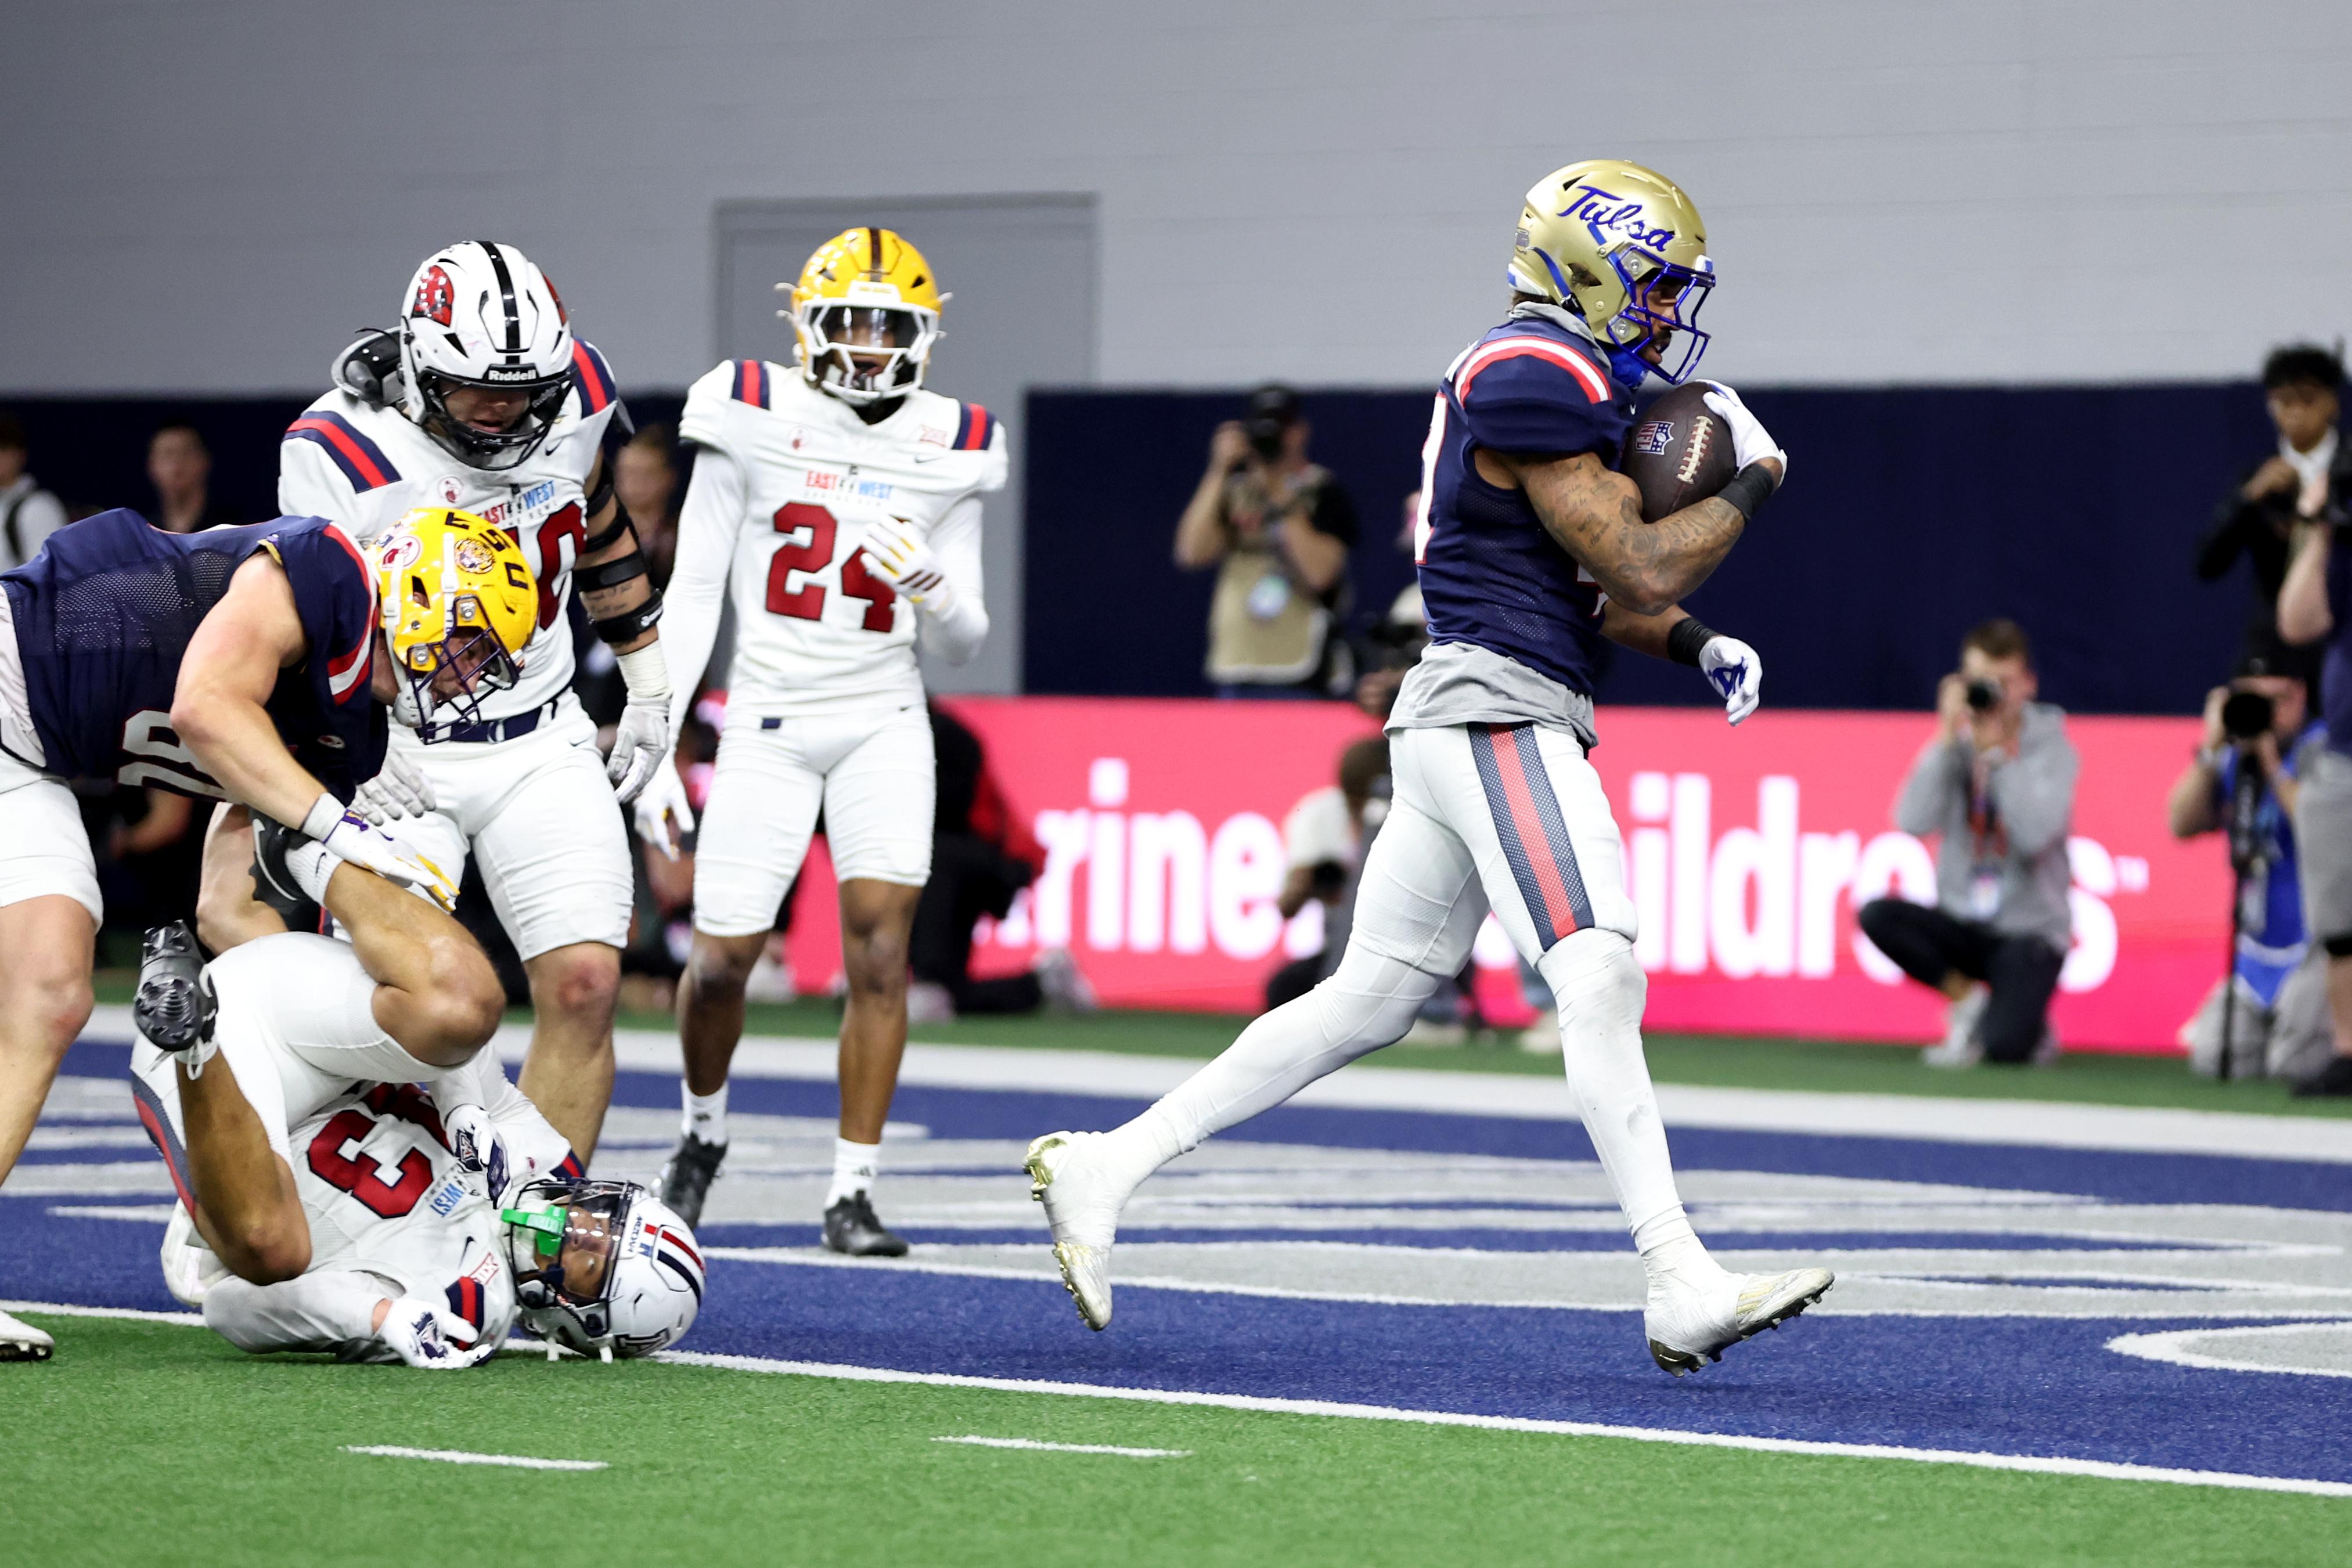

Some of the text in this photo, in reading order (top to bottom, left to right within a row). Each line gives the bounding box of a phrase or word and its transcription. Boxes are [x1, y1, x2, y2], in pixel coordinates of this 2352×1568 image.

[1557, 185, 1675, 252] Tulsa
[488, 370, 536, 381] Riddell
[1636, 423, 1658, 450] NFL
[478, 503, 506, 524] AST
[523, 481, 555, 509] WEST
[806, 470, 839, 490] EAST
[858, 480, 892, 499] WEST
[445, 511, 529, 590] LSU
[766, 502, 911, 633] 24
[430, 1183, 464, 1217] WEST
